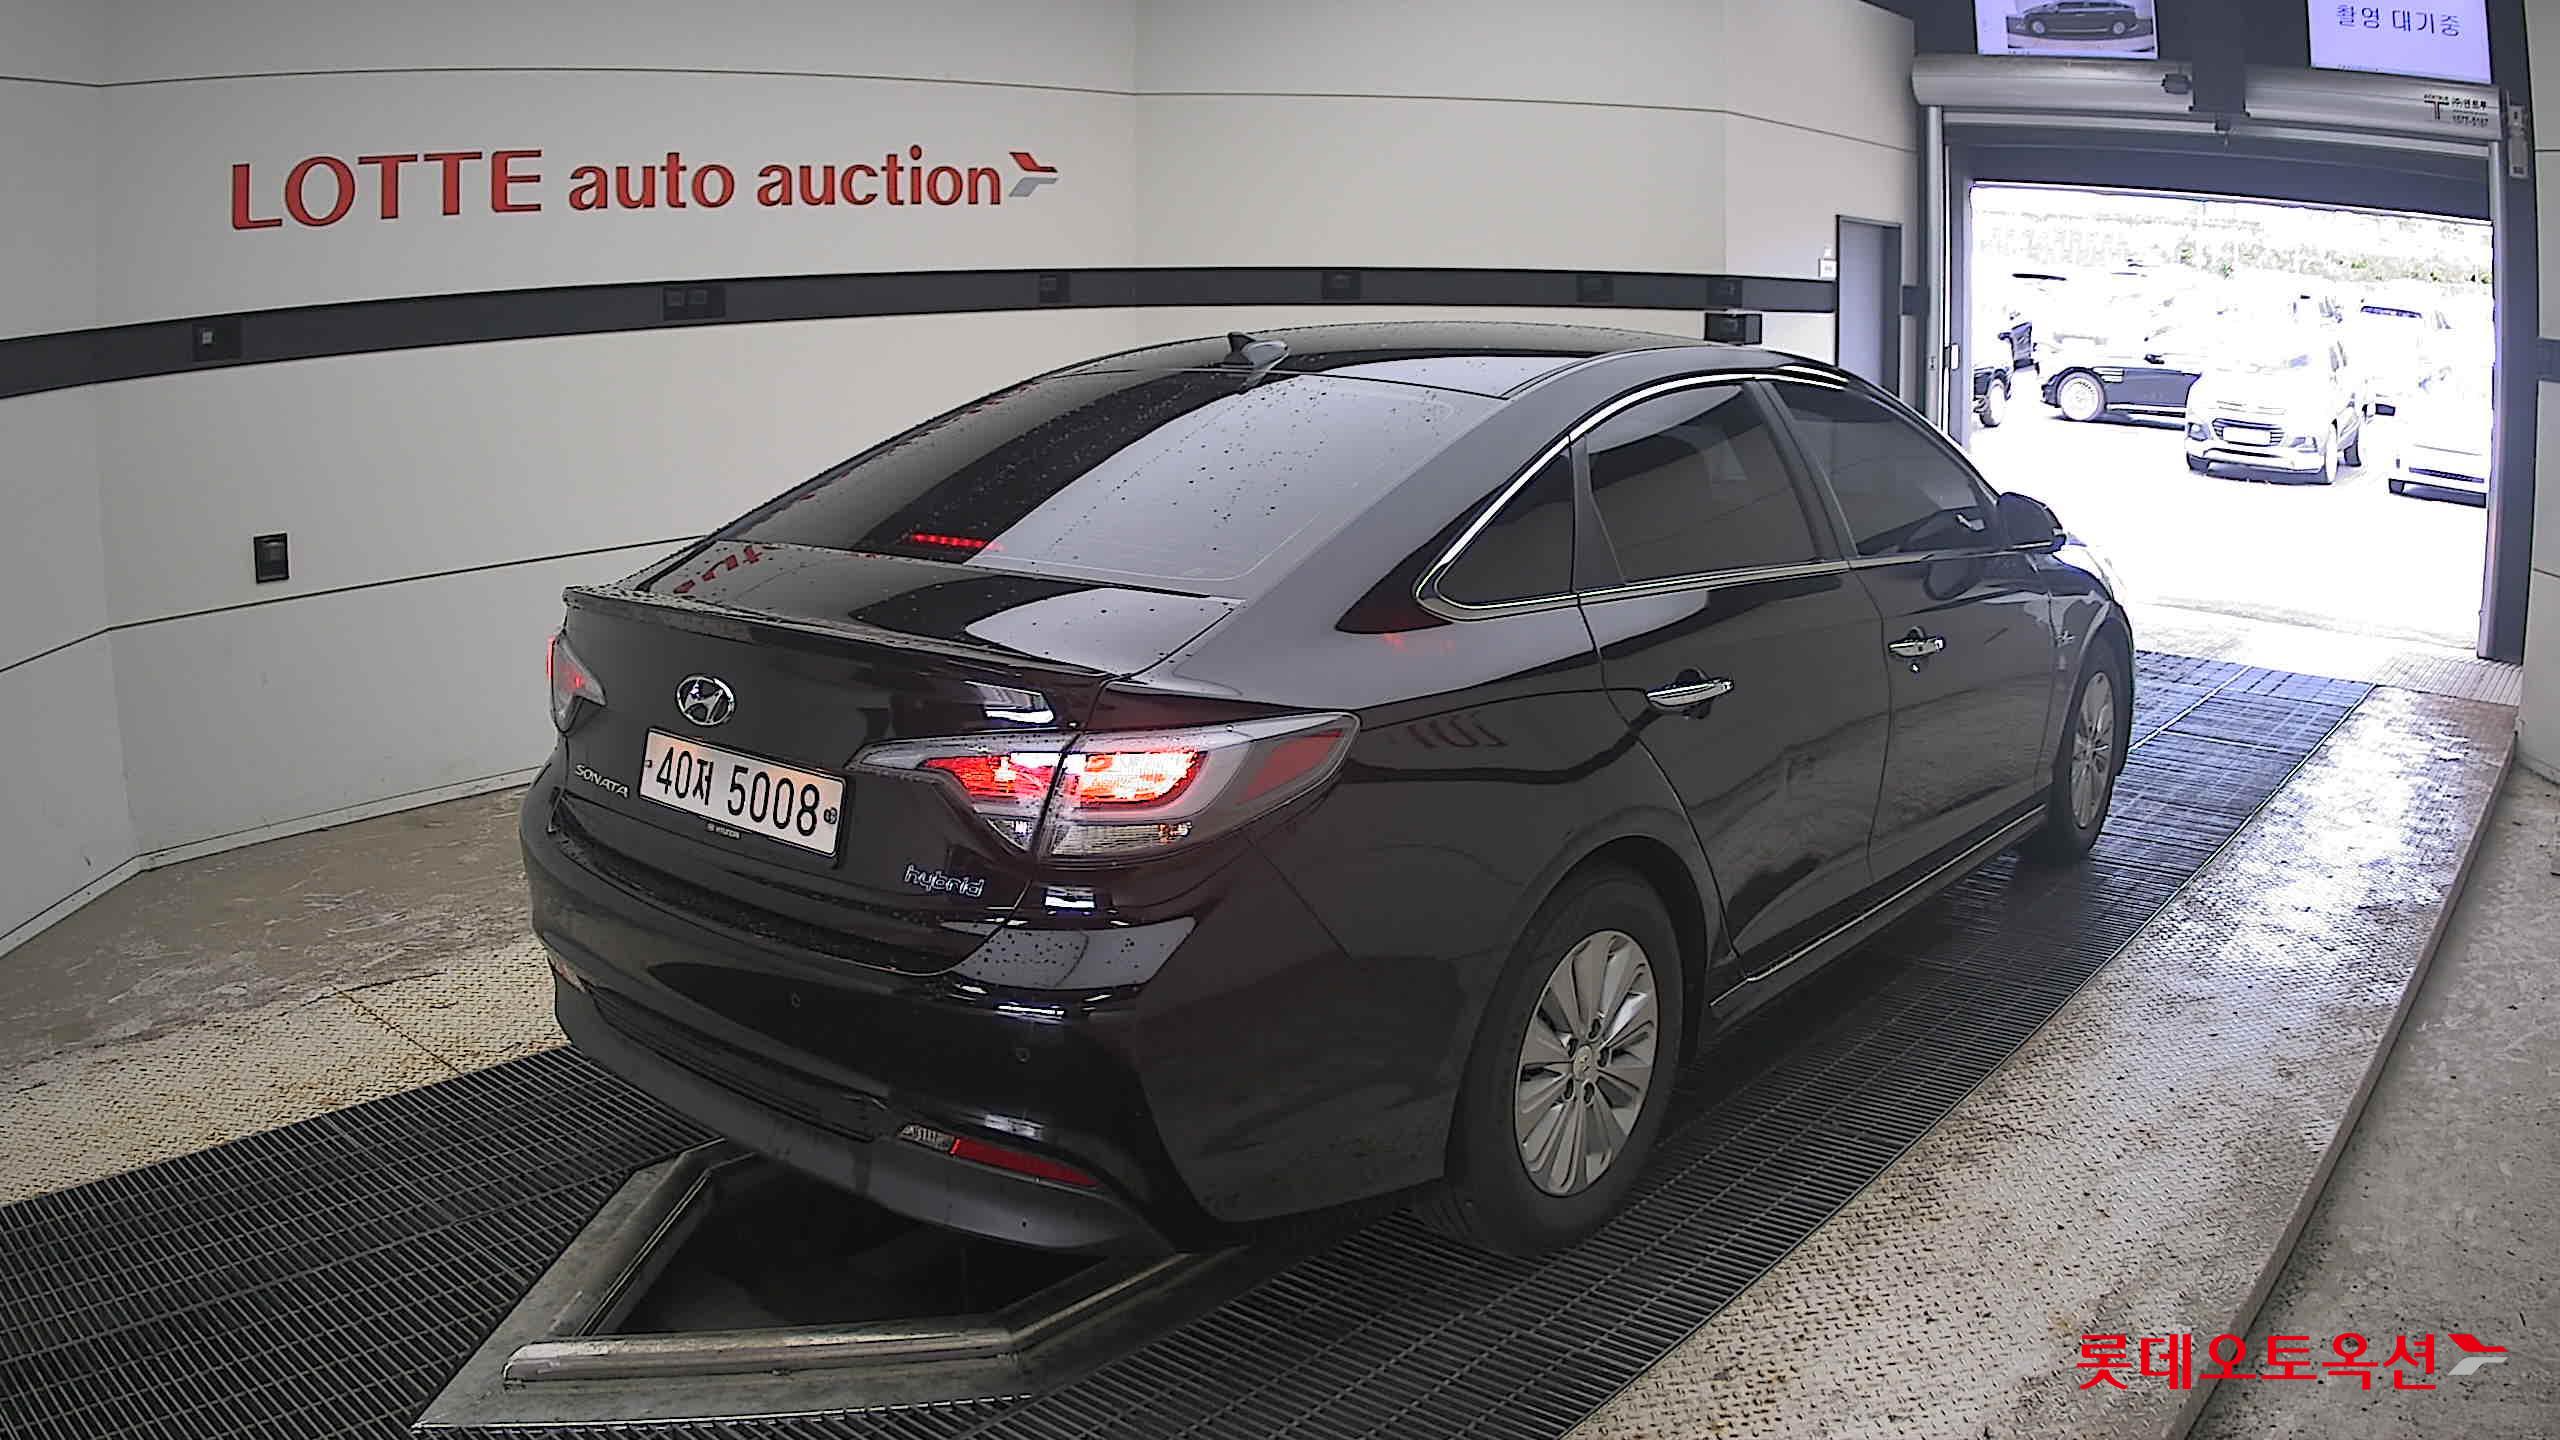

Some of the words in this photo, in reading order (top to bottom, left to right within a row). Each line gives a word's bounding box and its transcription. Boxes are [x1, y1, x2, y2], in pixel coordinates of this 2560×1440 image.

[2337, 4, 2381, 29] 촬영
[2391, 9, 2459, 37] 대기중
[231, 149, 542, 231] LOTTE
[567, 151, 736, 211] auto
[756, 144, 1002, 207] auction
[574, 762, 630, 800] SONATA
[655, 746, 715, 807] 40저
[727, 763, 822, 838] 5008
[903, 863, 985, 898] hybrid
